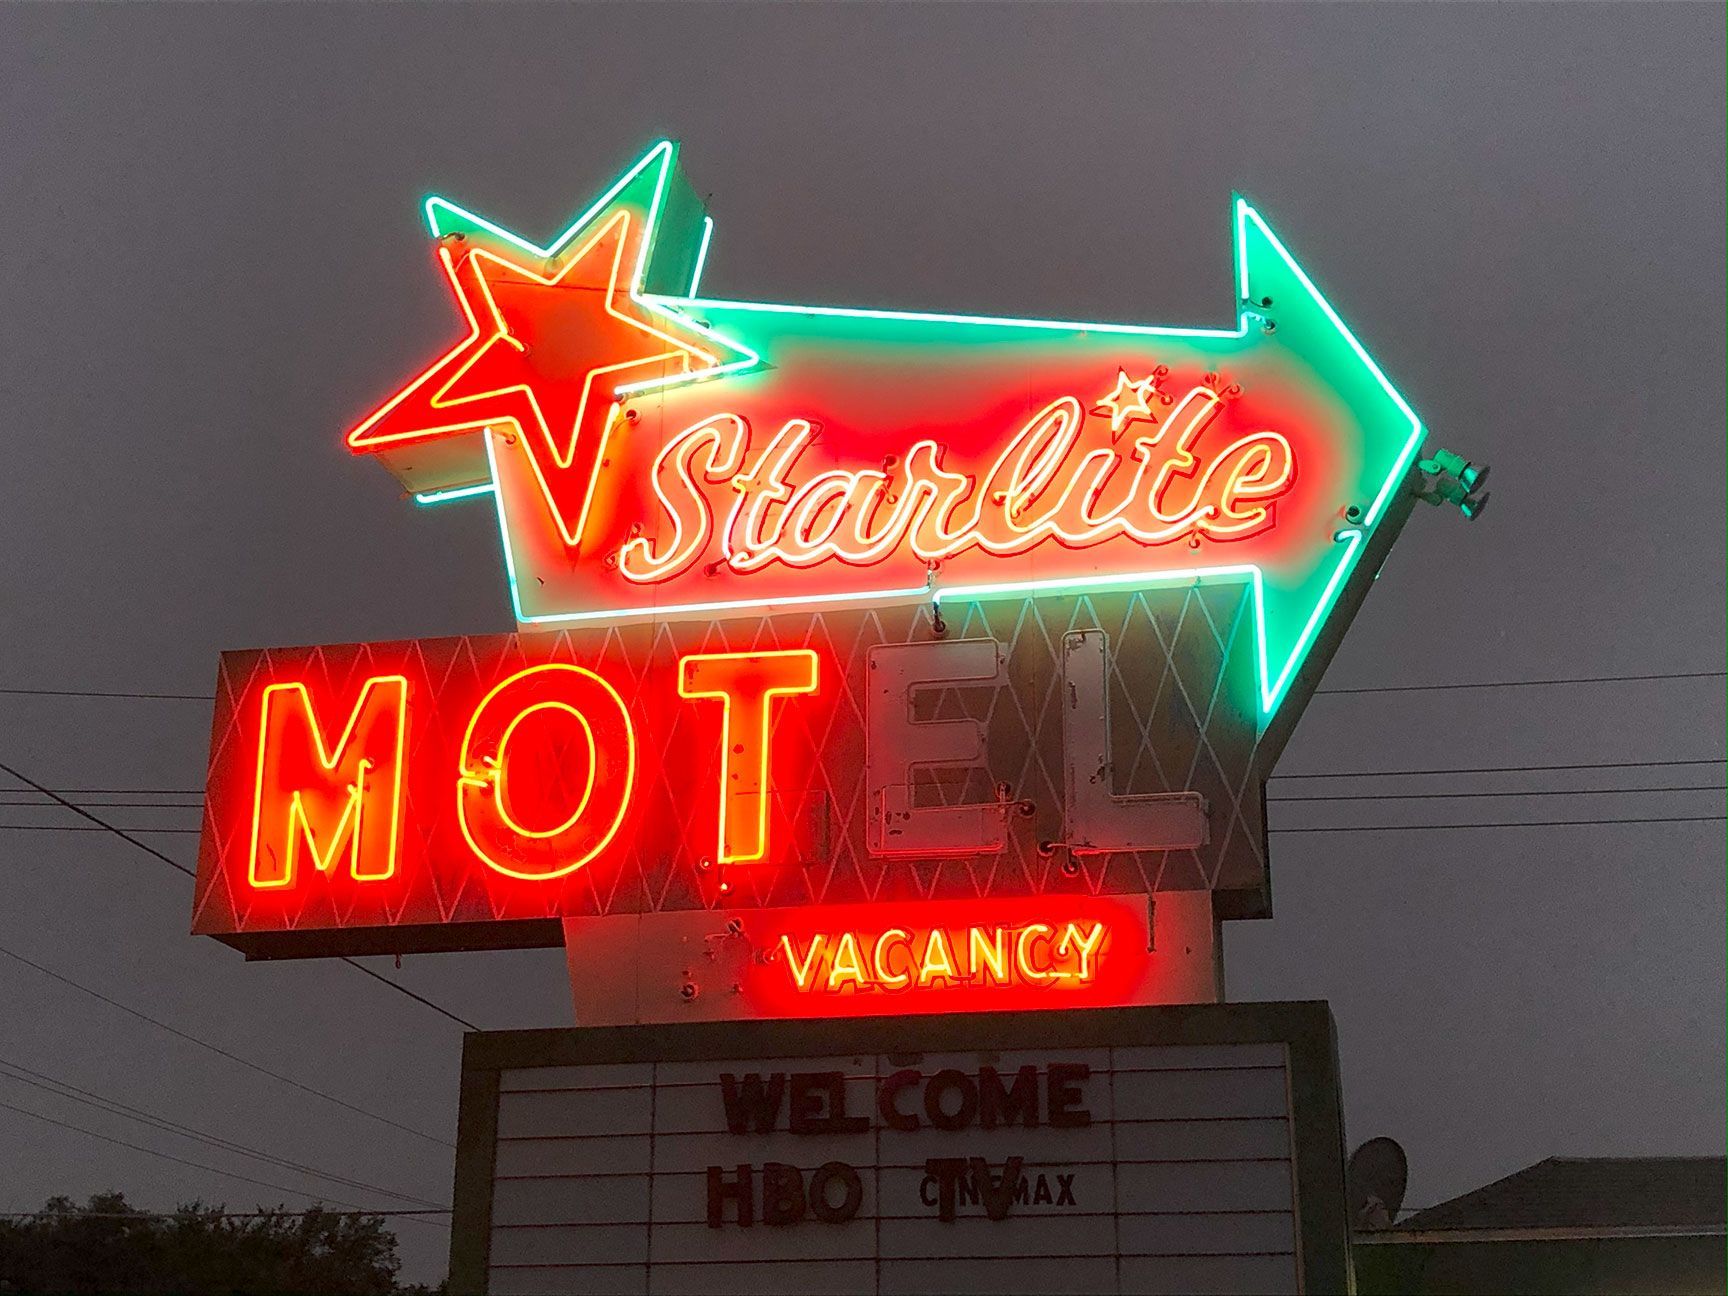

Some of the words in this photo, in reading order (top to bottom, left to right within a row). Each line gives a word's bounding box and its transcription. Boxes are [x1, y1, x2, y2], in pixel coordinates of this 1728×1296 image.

[619, 386, 1293, 584] Starlite
[248, 630, 1209, 888] MOTEL
[780, 922, 1107, 992] VACANCY
[720, 1063, 1091, 1134] WELCOME
[706, 1161, 862, 1228] HBO
[919, 1174, 1076, 1207] CNMAX
